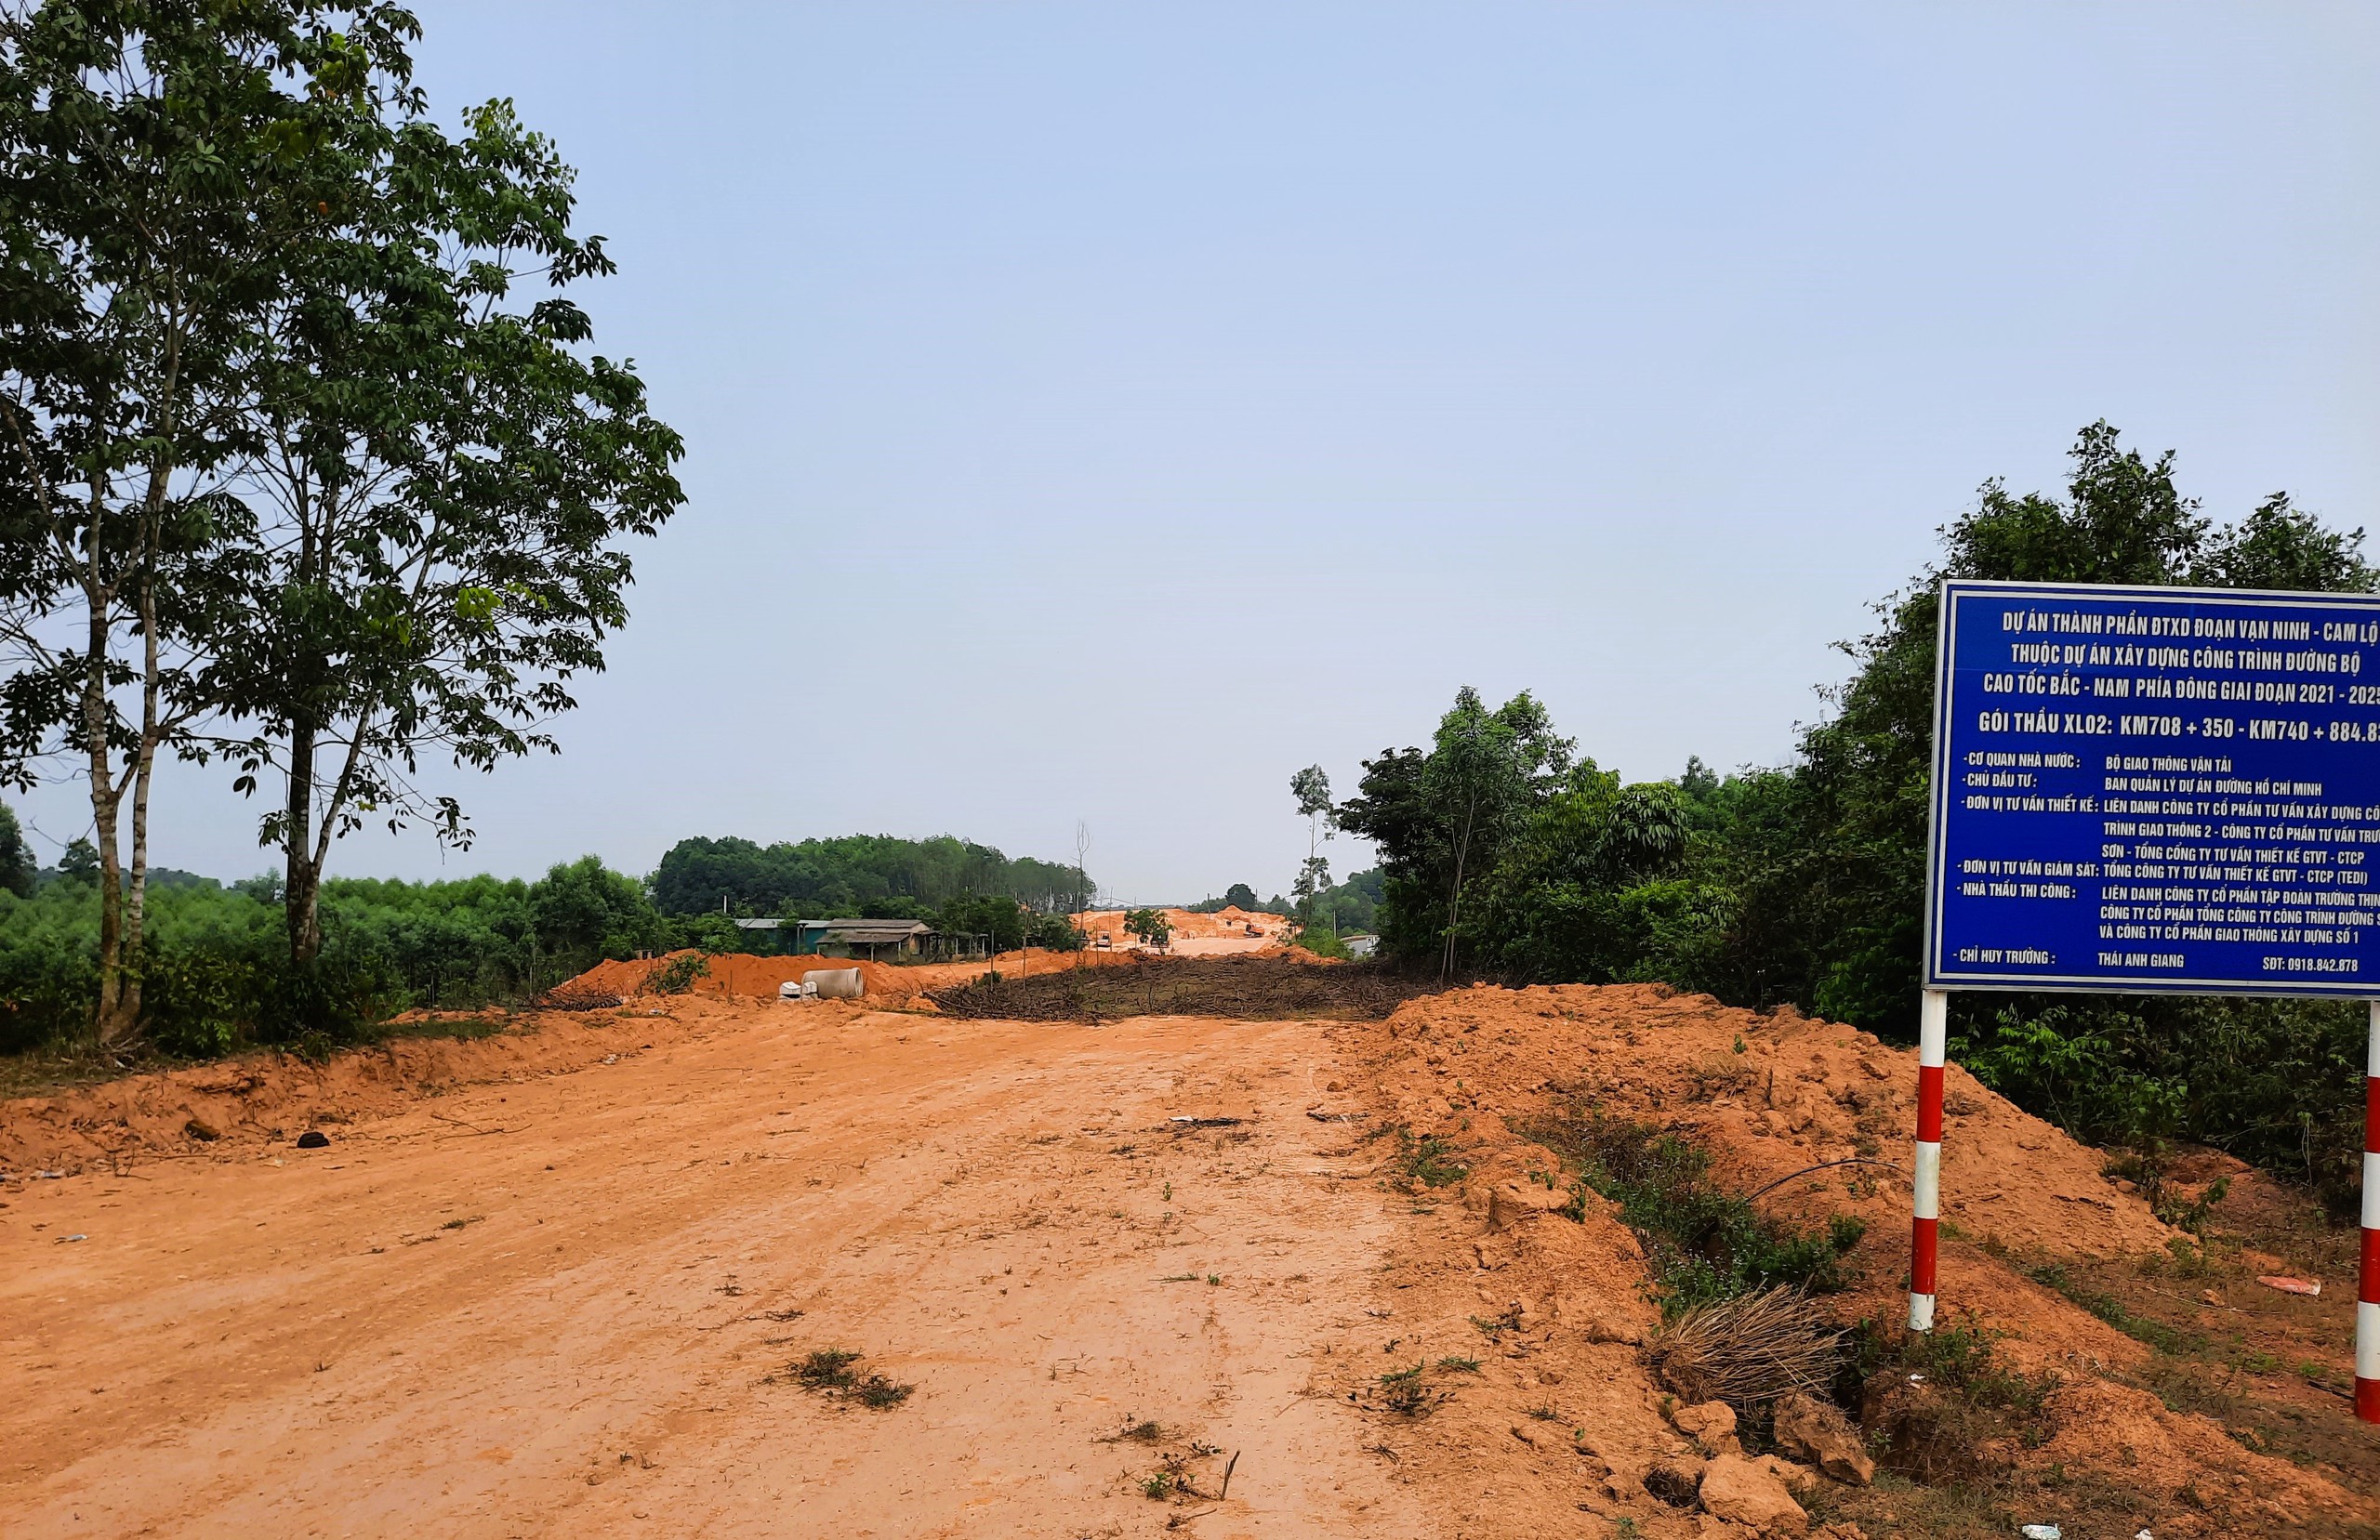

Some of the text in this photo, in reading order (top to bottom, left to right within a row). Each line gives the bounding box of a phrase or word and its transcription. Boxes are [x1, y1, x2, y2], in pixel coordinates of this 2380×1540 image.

[2003, 612, 2025, 634] DỰ
[2027, 609, 2048, 631] ÁN
[2053, 611, 2102, 633] THÀNH
[2152, 617, 2189, 636] ĐTXD
[2194, 619, 2235, 640] ĐOẠN
[2240, 620, 2268, 641] VẠN
[2273, 622, 2309, 640] NINH
[2323, 623, 2356, 641] CAM
[2360, 621, 2377, 646] LỘ
[2012, 640, 2060, 666] THUỘC
[2065, 644, 2085, 667] DỰ
[2089, 642, 2110, 665] ÁN
[2114, 644, 2144, 665] XÂY
[2148, 647, 2188, 670] DỰNG
[2193, 646, 2233, 668] CÔNG
[2286, 649, 2336, 672] ĐƯỜNG
[2341, 652, 2360, 677] BỘ
[1984, 674, 2013, 692] CAO
[2018, 668, 2045, 693] TỐC
[2050, 669, 2080, 695] BẮC
[2095, 678, 2129, 697] NAM
[2136, 676, 2171, 698] PHÍA
[2175, 677, 2216, 699] ĐÔNG
[2221, 681, 2251, 700] GIAI
[2255, 683, 2295, 704] ĐOẠN
[2299, 684, 2334, 703] 2021
[1979, 708, 2008, 731] GÓI
[2064, 714, 2111, 734] XL02:
[2121, 716, 2181, 736] KM708
[2187, 722, 2197, 734] +
[2202, 718, 2233, 737] 350
[2250, 720, 2307, 740] KM740
[2314, 727, 2323, 739] +
[2330, 722, 2380, 742] 884.8
[1987, 753, 2016, 767] QUAN
[2019, 752, 2041, 767] NHÀ
[2106, 755, 2120, 771] BỘ
[2124, 757, 2149, 770] GIAO
[2152, 756, 2188, 770] THÔNG
[2191, 757, 2212, 773] VẬN
[2215, 756, 2230, 772] TẢI
[2105, 777, 2127, 790] BAN
[2131, 774, 2160, 792] QUẢN
[2163, 777, 2175, 792] LÝ
[2179, 779, 2194, 795] DỰ
[2197, 778, 2211, 793] ÁN
[2215, 778, 2252, 794] ĐƯỜNG
[2273, 780, 2290, 795] CHÍ
[2294, 783, 2321, 796] MINH
[1993, 797, 2003, 812] VỊ
[2006, 796, 2020, 810] TƯ
[2023, 794, 2044, 810] VẤN
[2048, 794, 2077, 811] THIẾT
[2104, 797, 2127, 812] LIÊN
[2130, 800, 2159, 813] DANH
[2162, 799, 2193, 814] CÔNG
[2197, 802, 2209, 815] TY
[2214, 797, 2228, 815] CỔ
[2266, 804, 2280, 817] TƯ
[2282, 801, 2304, 818] VẤN
[2307, 804, 2328, 818] XÂY
[2332, 806, 2361, 822] DỰNG
[2139, 823, 2163, 836] GIAO
[2166, 822, 2202, 837] THÔNG
[2204, 825, 2211, 837] 2
[2222, 823, 2251, 838] CÔNG
[2254, 826, 2266, 839] TY
[2269, 823, 2283, 839] CỔ
[2319, 828, 2333, 841] TƯ
[2334, 826, 2355, 842] VẤN
[2359, 829, 2380, 843] TRƯ
[2102, 844, 2123, 858] SƠN
[2135, 841, 2162, 859] TỔNG
[2199, 849, 2211, 861] TY
[2215, 848, 2228, 862] TƯ
[2230, 846, 2251, 862] VẤN
[2255, 847, 2283, 862] THIẾT
[2287, 848, 2300, 862] KẾ
[2303, 850, 2327, 863] GTVT
[2338, 851, 2364, 864] CTCP
[1964, 860, 1986, 873] ĐƠN
[1990, 862, 2000, 876] VỊ
[2003, 862, 2017, 875] TƯ
[2019, 860, 2041, 875] VẤN
[2044, 861, 2072, 876] GIÁM
[2104, 860, 2131, 877] TỔNG
[2135, 862, 2164, 878] CÔNG
[2168, 866, 2180, 878] TY
[2183, 865, 2197, 879] TƯ
[2200, 864, 2221, 880] VẤN
[2224, 865, 2253, 881] THIẾT
[2256, 865, 2270, 881] KẾ
[2273, 869, 2297, 882] GTVT
[2307, 870, 2334, 883] CTCP
[2337, 871, 2367, 885] (TEDI)
[1964, 880, 1986, 895] NHÀ
[2020, 885, 2037, 897] THI
[2102, 885, 2127, 900] LIÊN
[2131, 888, 2162, 901] DANH
[2165, 886, 2193, 902] CÔNG
[2197, 889, 2209, 902] TY
[2213, 884, 2227, 902] CỔ
[2261, 888, 2280, 906] TẬP
[2283, 889, 2311, 904] ĐOÀN
[2315, 889, 2355, 905] TRƯỜNG
[2101, 904, 2129, 919] CÔNG
[2133, 907, 2145, 919] TY
[2148, 902, 2162, 920] CỔ
[2197, 903, 2224, 921] TỔNG
[2228, 907, 2255, 922] CÔNG
[2259, 911, 2271, 923] TY
[2274, 908, 2302, 923] CÔNG
[2338, 908, 2373, 925] ĐƯỜNG
[2117, 923, 2146, 939] CÔNG
[2149, 927, 2162, 939] TY
[2165, 922, 2179, 939] CỔ
[2215, 928, 2240, 941] GIAO
[2243, 927, 2277, 941] THÔNG
[2281, 928, 2301, 942] XÂY
[2305, 929, 2333, 945] DỰNG
[2336, 927, 2350, 943] SỐ
[2354, 931, 2358, 943] 1
[1960, 945, 1977, 962] CHỈ
[1981, 950, 2003, 963] HUY
[2098, 951, 2122, 966] THÁI
[2125, 954, 2148, 967] ANH
[2151, 954, 2184, 967] GIANG
[2263, 957, 2284, 970] SĐT:
[2288, 958, 2358, 971] 0918.842.878
